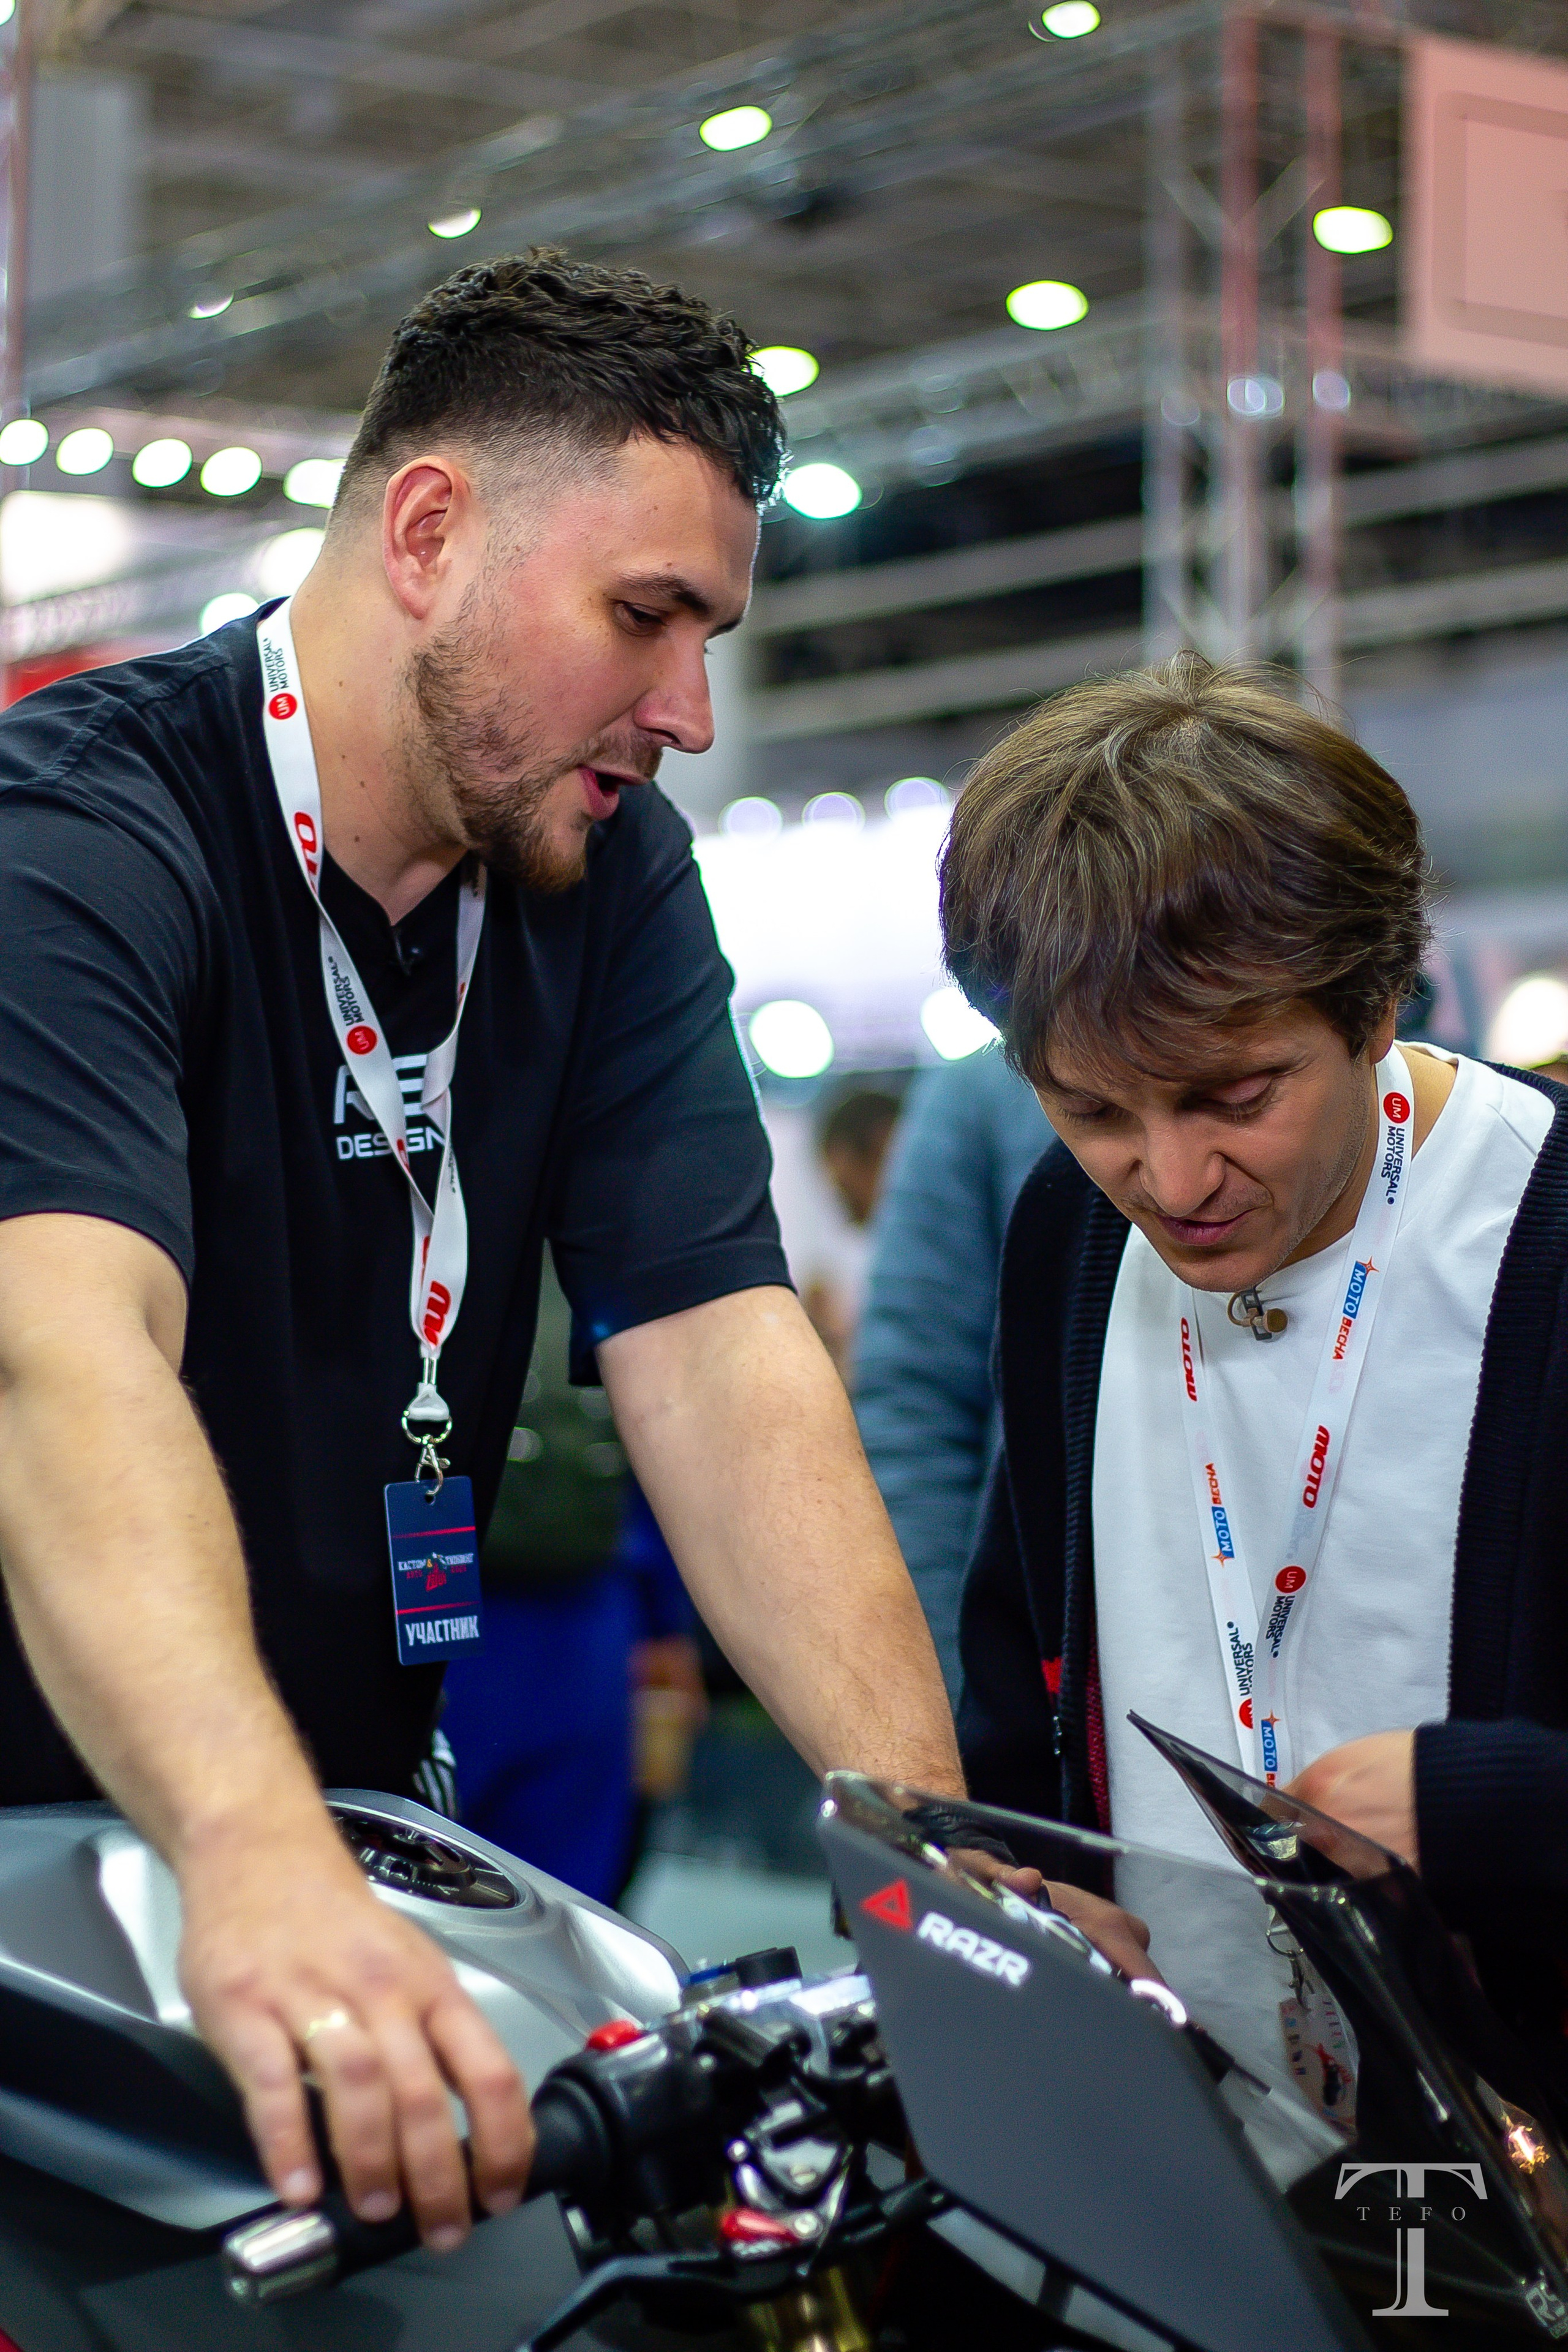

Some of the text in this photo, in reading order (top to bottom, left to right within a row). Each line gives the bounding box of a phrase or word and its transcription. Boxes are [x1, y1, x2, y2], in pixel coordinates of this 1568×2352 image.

[274, 647, 289, 690] MOTORS
[1391, 1097, 1402, 1119] UM
[336, 1126, 447, 1160] DESGN
[1381, 1125, 1396, 1178] MOTORS
[1284, 1571, 1298, 1589] UM
[405, 1615, 480, 1646] УЧАСТНИК
[1265, 1595, 1286, 1640] MOTORS
[918, 1912, 1030, 1986] RAZR
